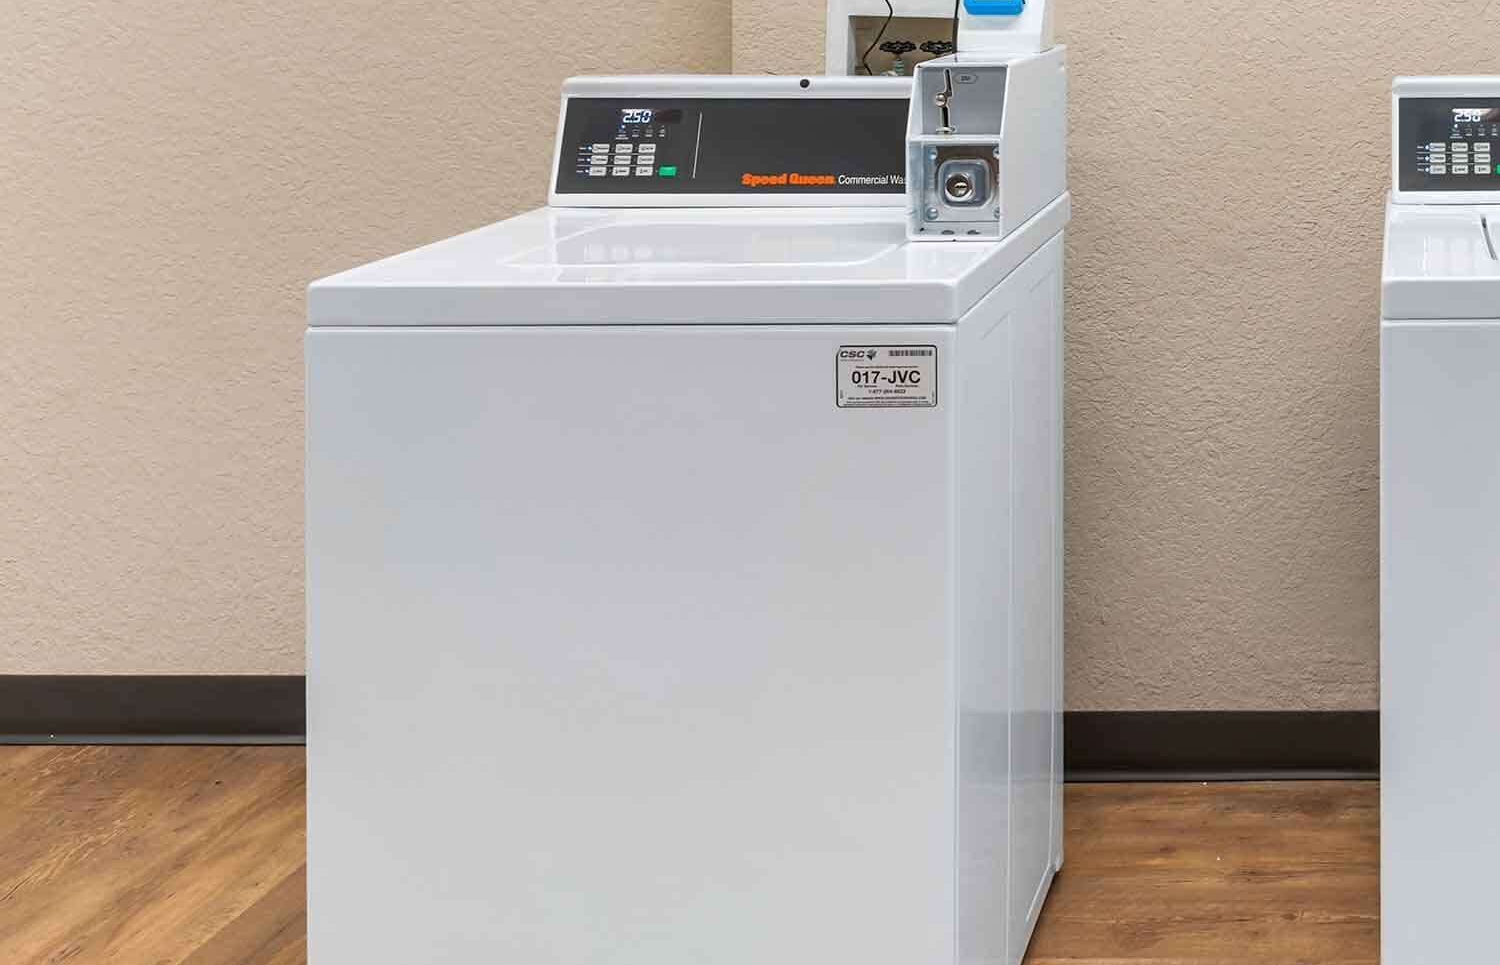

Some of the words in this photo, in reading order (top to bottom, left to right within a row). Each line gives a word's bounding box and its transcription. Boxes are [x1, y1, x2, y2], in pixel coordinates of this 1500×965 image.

[741, 172, 788, 186] Speed
[789, 172, 836, 185] Queen
[838, 174, 889, 185] Commercial
[840, 350, 865, 358] CSC
[851, 370, 921, 384] 017-JVC
